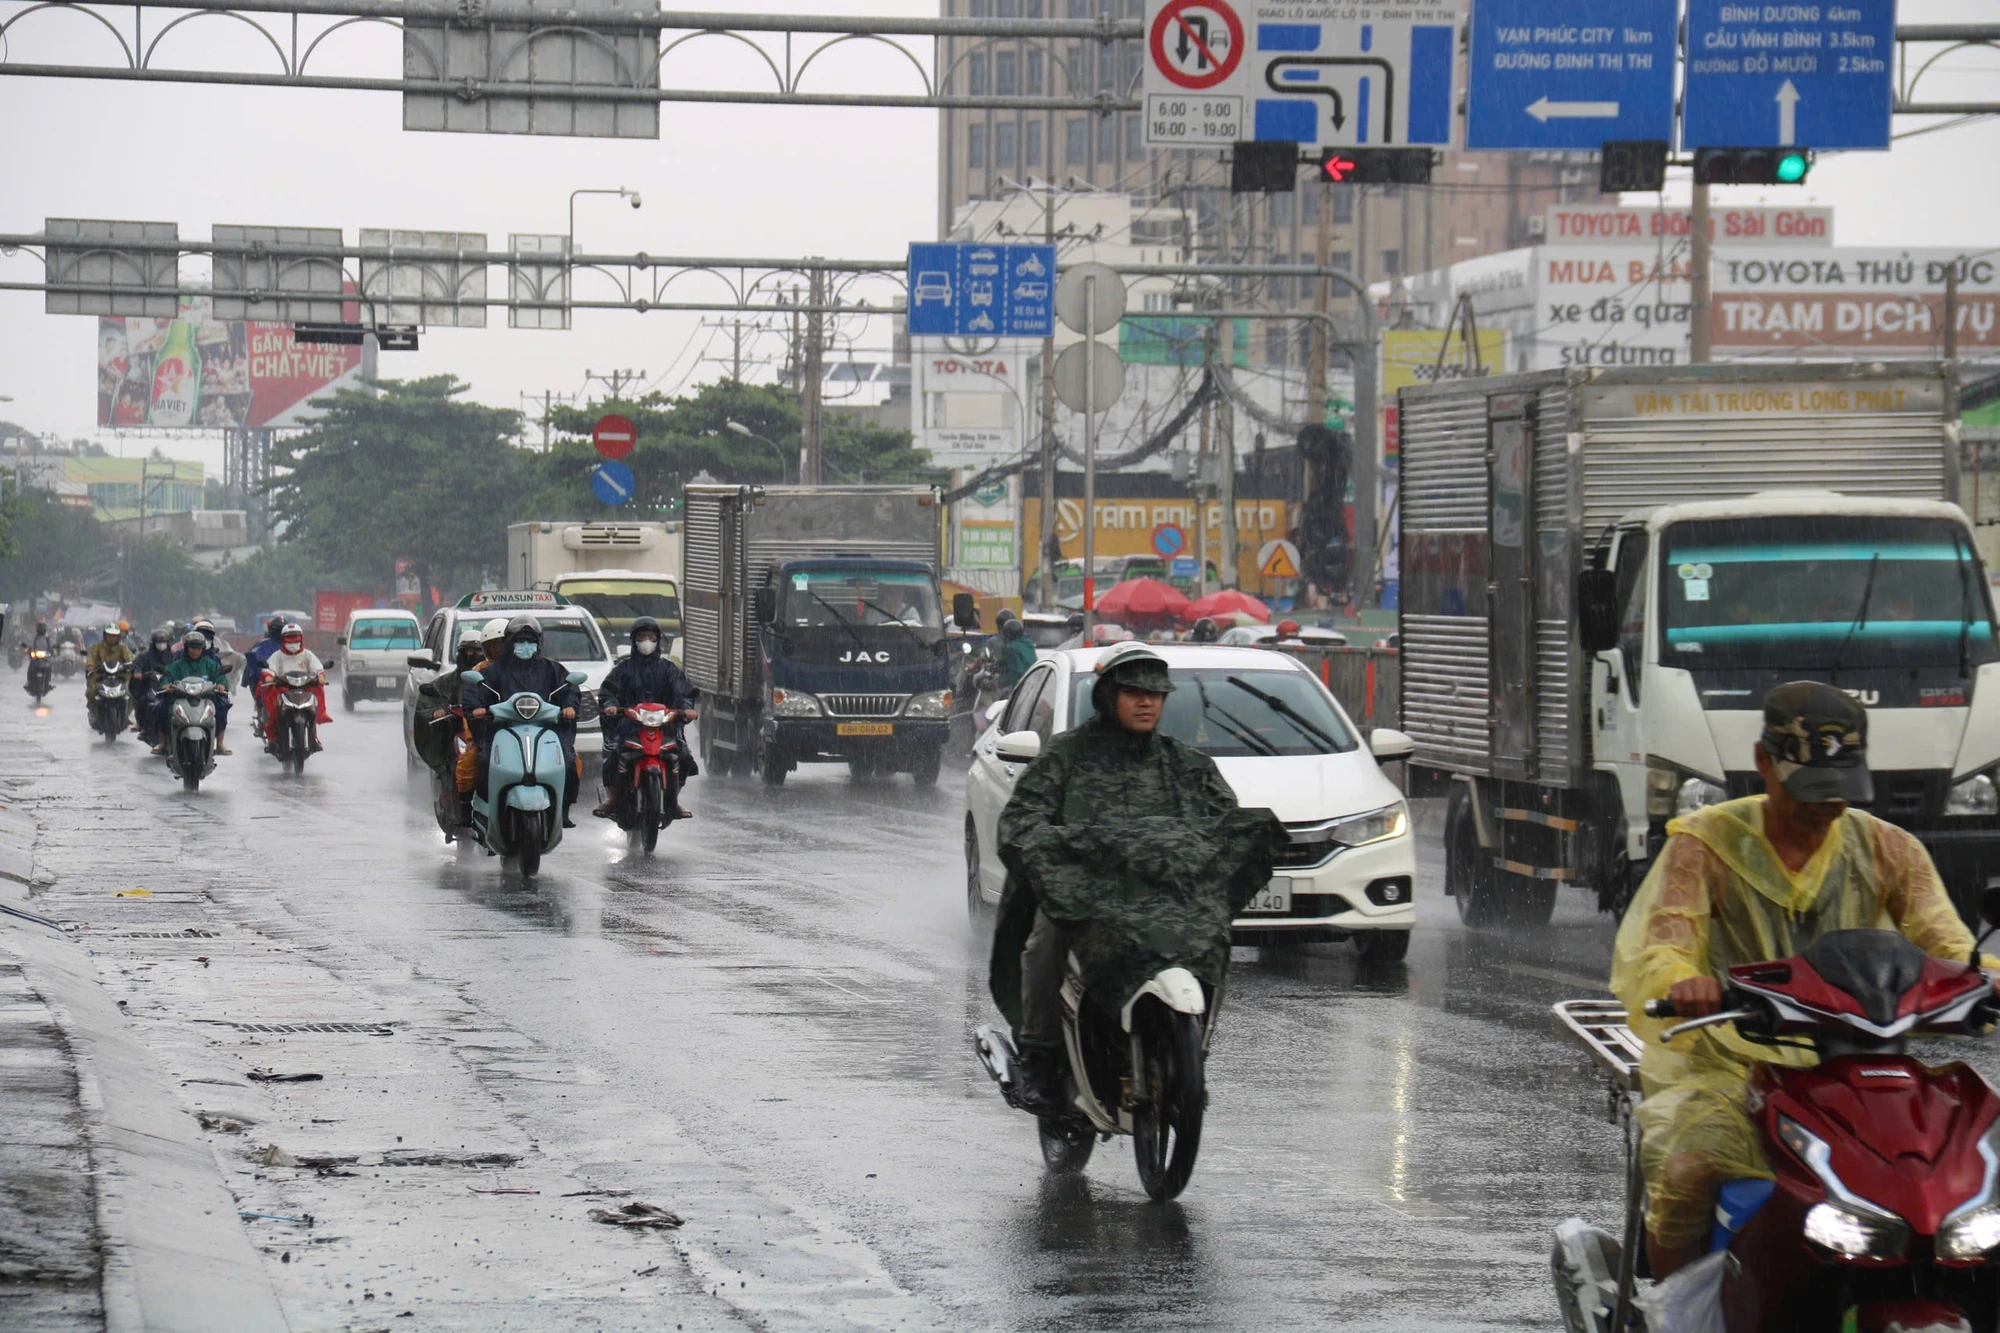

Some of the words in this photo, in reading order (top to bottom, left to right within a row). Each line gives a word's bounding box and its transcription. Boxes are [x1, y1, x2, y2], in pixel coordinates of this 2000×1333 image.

[1257, 8, 1285, 18] GIAO
[1721, 5, 1759, 22] BÌNH
[1764, 5, 1820, 22] DƯƠNG
[1828, 7, 1861, 22] 4km
[1497, 27, 1530, 45] VẠN
[1534, 24, 1578, 43] PHÚC
[1582, 27, 1614, 43] CITY
[1624, 27, 1653, 43] 1km
[1783, 28, 1822, 47] BÌNH
[1829, 32, 1876, 47] 3.5km
[1494, 51, 1551, 70] ĐƯỜNG
[1554, 53, 1595, 69] ĐINH
[1628, 53, 1653, 69] THI
[1694, 58, 1739, 73] ĐƯỜNG
[1773, 54, 1818, 72] MƯỜI
[1838, 56, 1885, 72] 2.5km
[1556, 213, 1642, 237] TOYOTA
[1724, 211, 1765, 237] Sài
[1775, 212, 1825, 237] Gòn
[1549, 260, 1616, 284] MUA
[1728, 260, 1845, 285] TOYOTA
[1856, 252, 1914, 285] THỦ
[1550, 304, 1581, 322] xe
[1590, 298, 1625, 322] đã
[1721, 302, 1823, 340] TRẠM
[1836, 302, 1931, 340] DỊCH
[933, 359, 1008, 374] TOTA
[1634, 389, 1672, 414] VẬN
[1716, 387, 1794, 413] TRƯỜNG
[1799, 390, 1849, 412] LONG
[1855, 385, 1905, 410] PHÁT
[491, 594, 533, 602] VINASUN
[839, 651, 891, 663] JAC
[1861, 1070, 1911, 1078] HONDA
